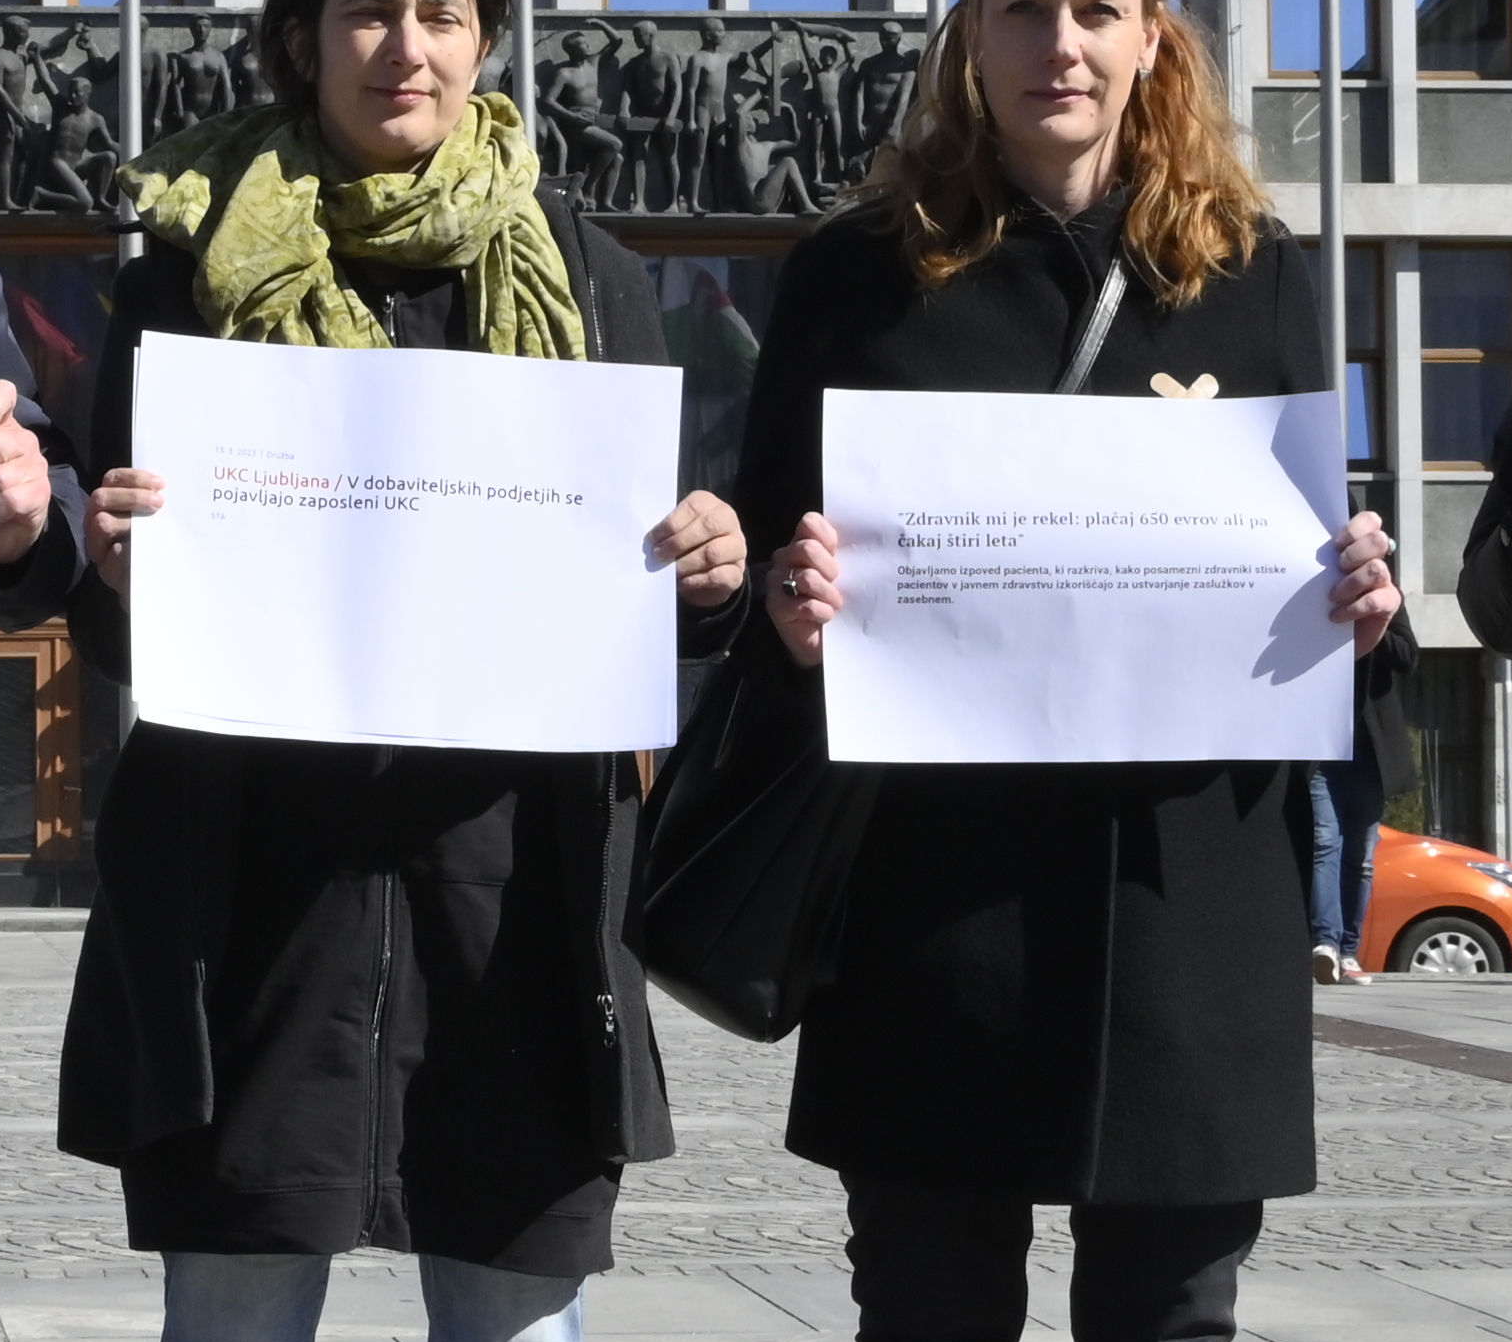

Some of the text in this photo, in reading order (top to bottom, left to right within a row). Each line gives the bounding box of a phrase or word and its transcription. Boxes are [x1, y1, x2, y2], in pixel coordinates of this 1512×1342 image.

[214, 466, 583, 506] UKC Ljubljana / V dobaviteljskih podjetjih se
[212, 487, 420, 512] pojavljajo zaposleni UKC
[986, 511, 1007, 526] mi
[1013, 511, 1027, 528] je
[1032, 511, 1080, 526] rekel:
[1085, 511, 1134, 529] plačaj
[1139, 512, 1169, 525] 650
[1173, 515, 1218, 526] evrov
[1223, 513, 1244, 527] ali
[1249, 517, 1268, 530] pa
[897, 532, 941, 551] čakaj
[946, 533, 980, 548] štiri
[897, 565, 957, 578] Objavljamo
[959, 564, 1001, 578] izpoved
[1054, 565, 1065, 575] ki
[1115, 564, 1141, 575] kako
[1143, 564, 1202, 577] posamezni
[1204, 564, 1252, 575] zdravniki
[1254, 564, 1287, 574] stiske
[896, 578, 1255, 592] pacientov v javnem zdravstvu izkoriščajo za ustvarjanje zaslužkov v
